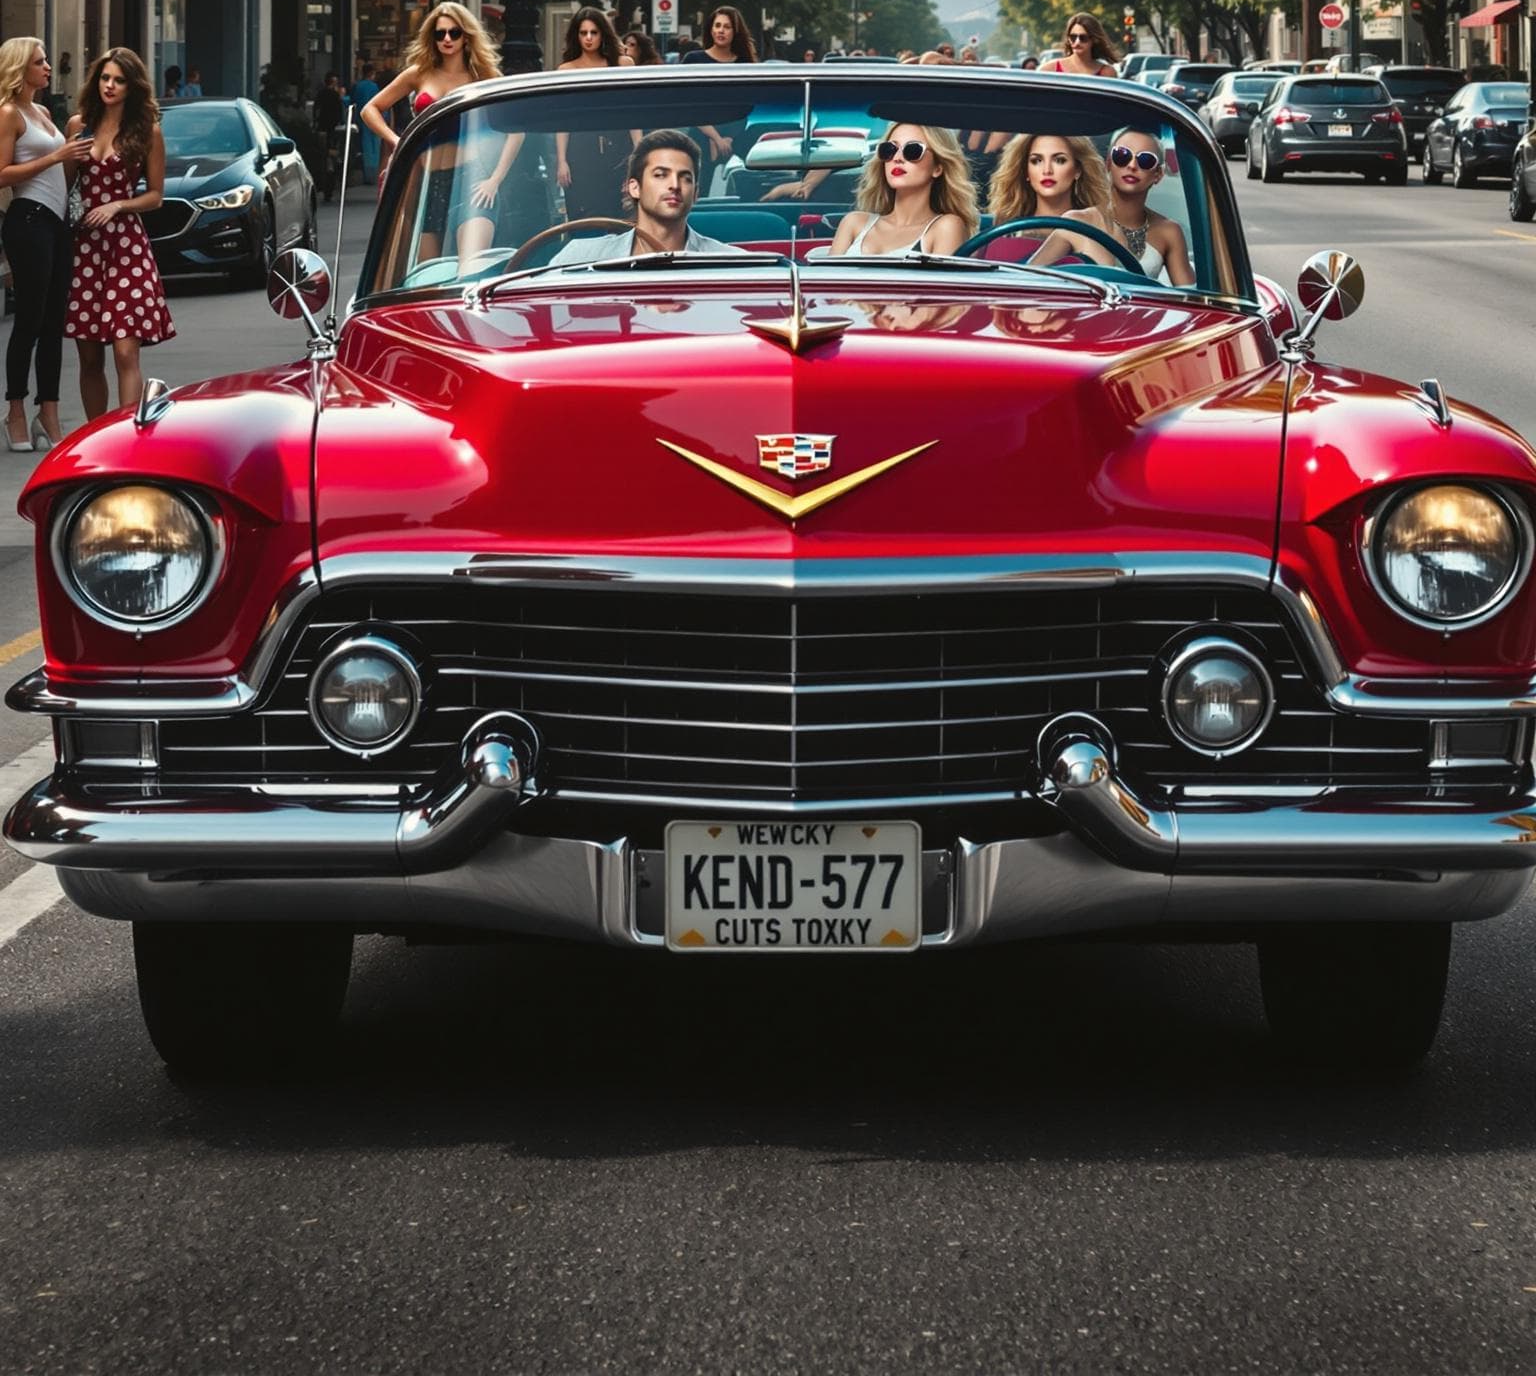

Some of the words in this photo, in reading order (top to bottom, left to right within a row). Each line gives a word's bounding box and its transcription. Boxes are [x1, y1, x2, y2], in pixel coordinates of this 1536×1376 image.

[684, 855, 904, 909] KEND-577
[715, 918, 781, 945] CUTS
[792, 918, 871, 945] TOXKY
